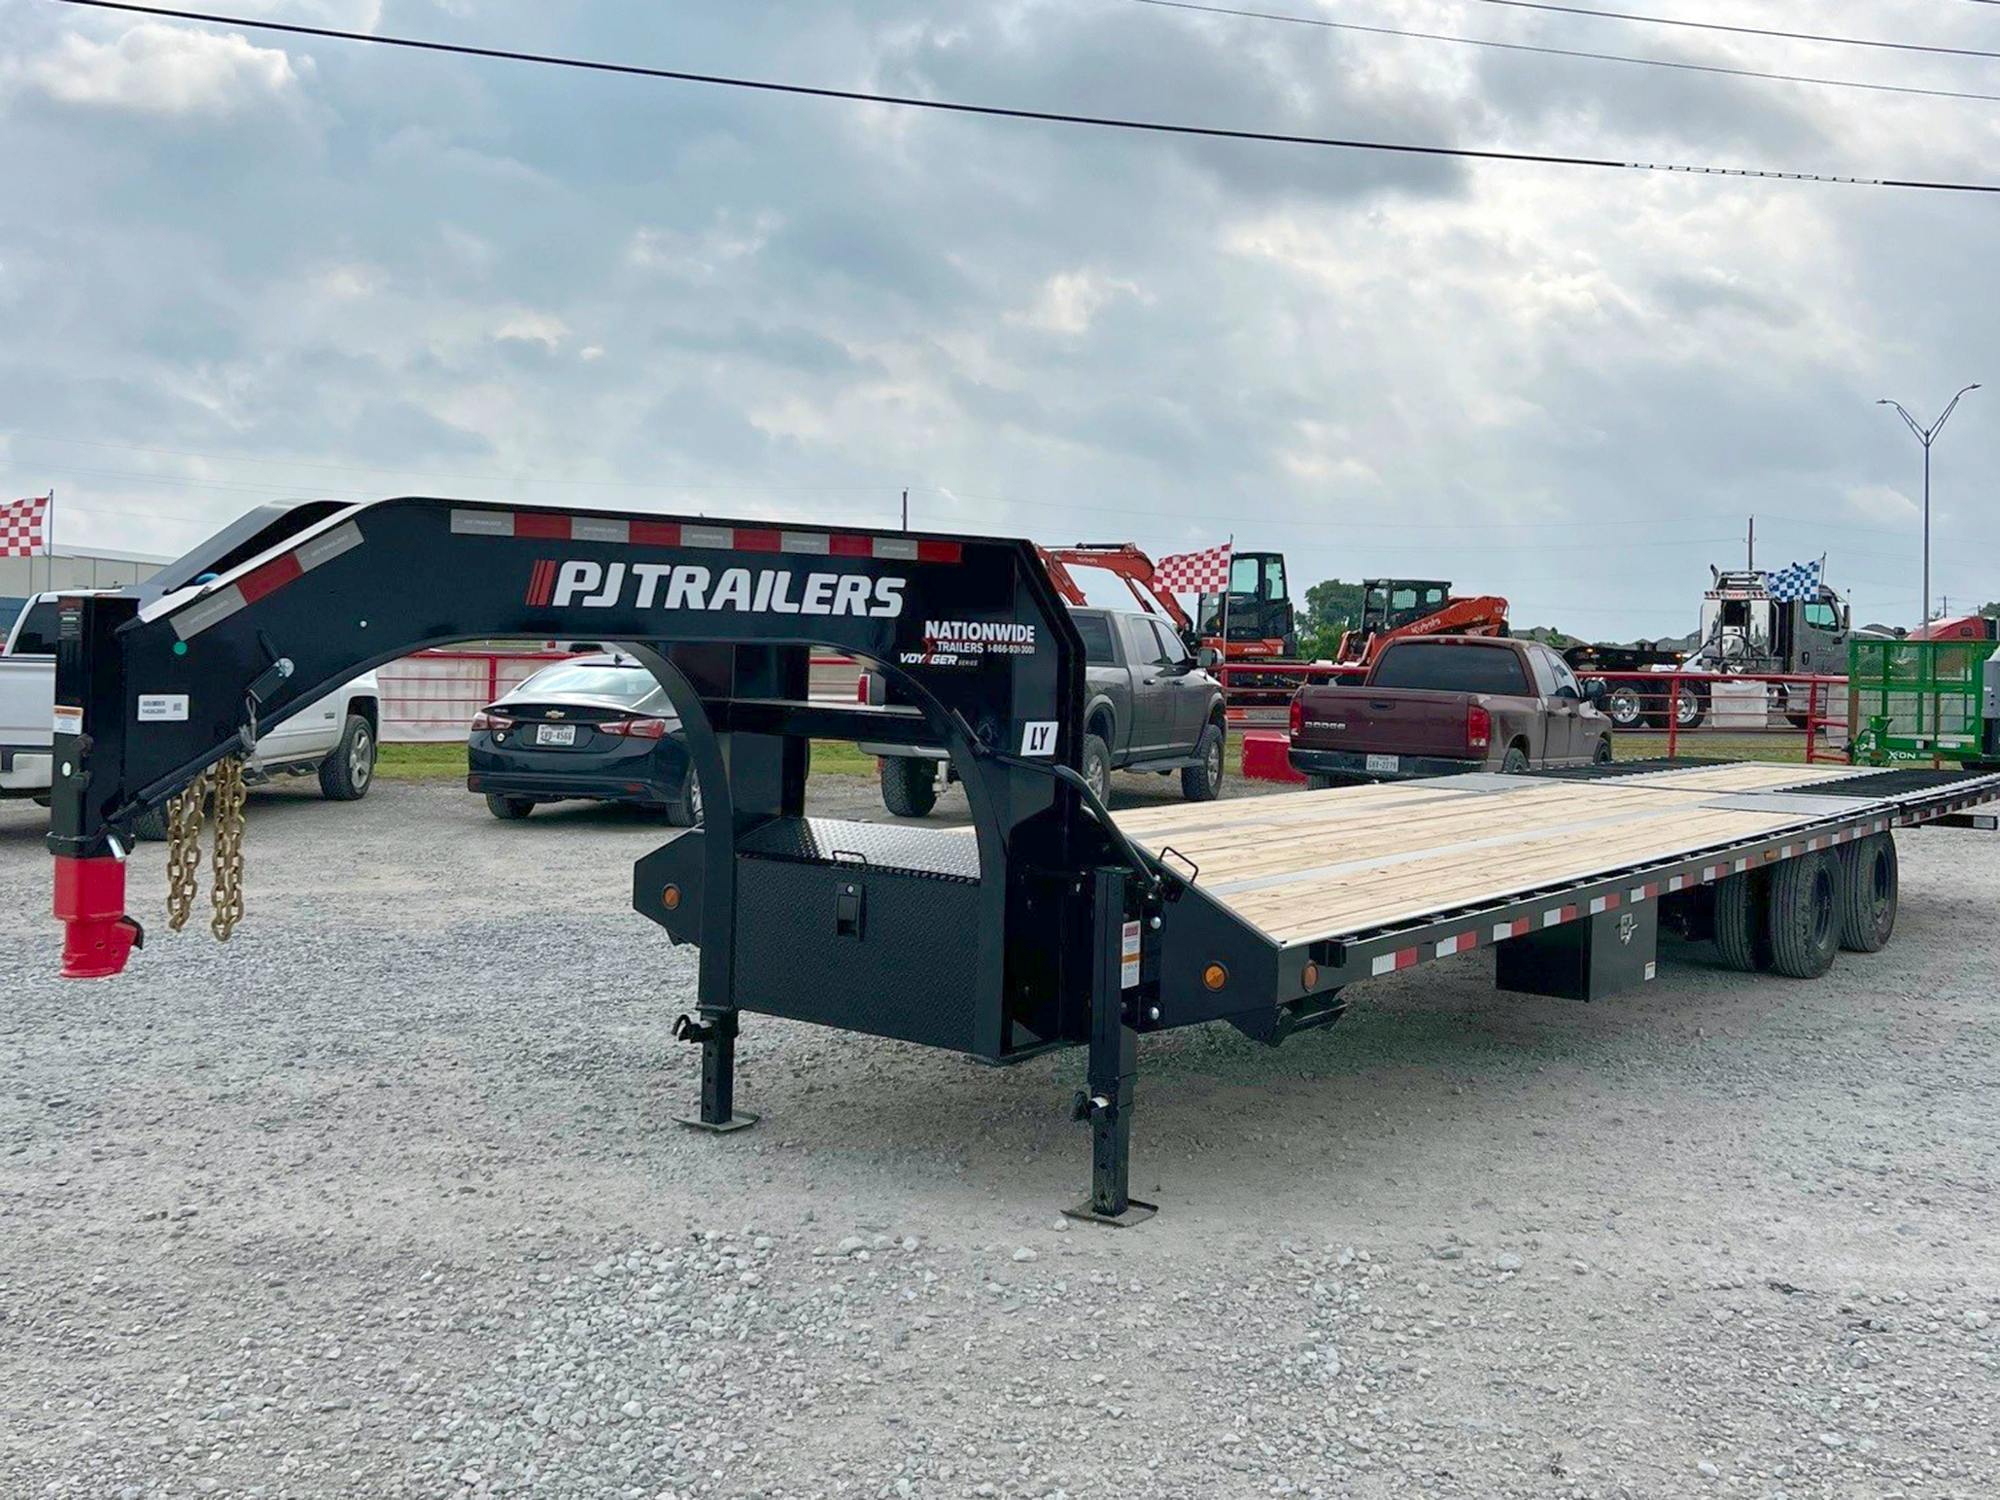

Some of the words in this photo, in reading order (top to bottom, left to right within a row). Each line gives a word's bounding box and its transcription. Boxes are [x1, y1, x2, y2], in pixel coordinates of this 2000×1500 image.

[552, 560, 626, 607] PJ
[632, 563, 906, 617] TRAILERS
[925, 620, 1035, 643] NATIONWIDE
[936, 641, 984, 653] TRAILERS
[900, 653, 958, 665] VOYAGER
[1305, 721, 1346, 730] DODGE
[1030, 726, 1050, 750] LY
